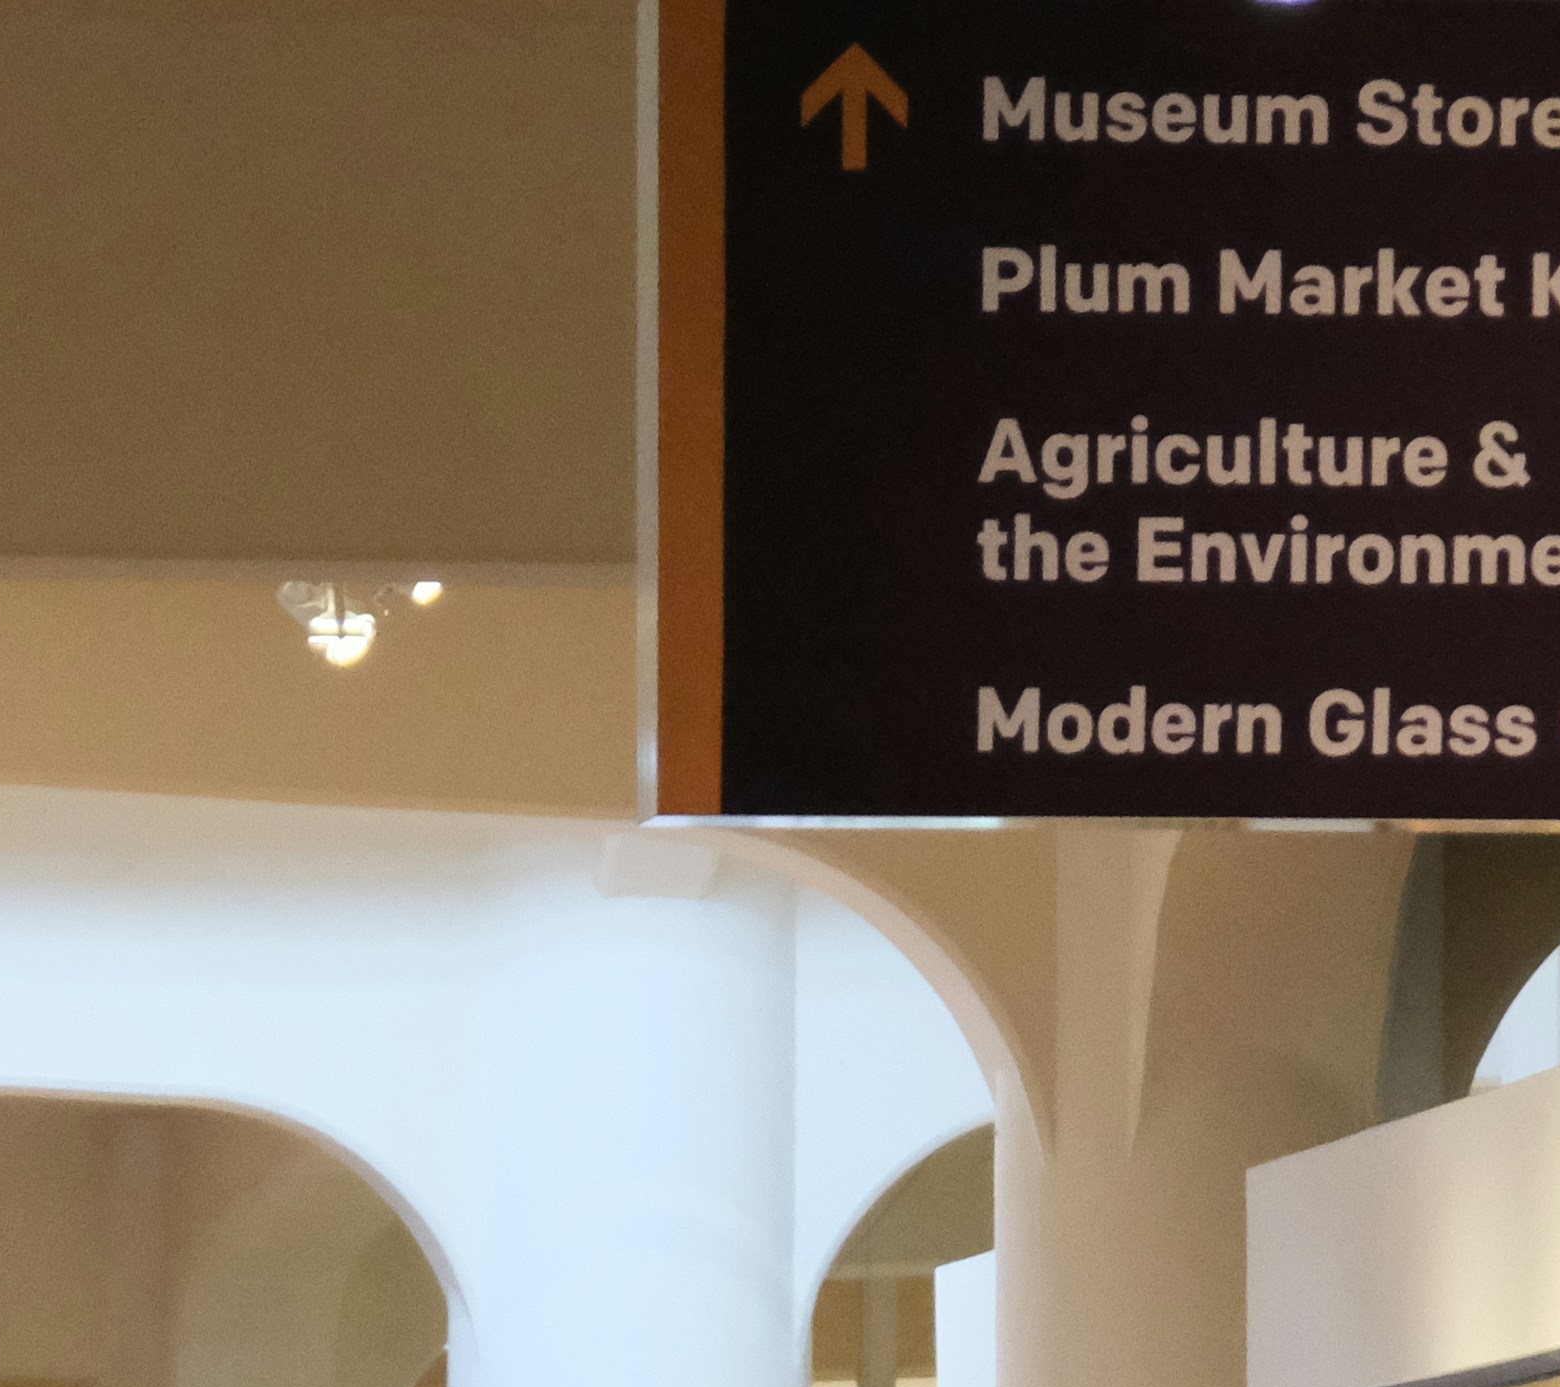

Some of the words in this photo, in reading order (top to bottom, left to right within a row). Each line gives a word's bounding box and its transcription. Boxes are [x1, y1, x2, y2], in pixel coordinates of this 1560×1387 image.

[982, 75, 1330, 146] Museum
[980, 243, 1191, 315] Plum
[1217, 246, 1507, 319] Market
[978, 414, 1450, 500] Agriculture
[1471, 419, 1532, 489] &
[976, 513, 1110, 584] the
[976, 684, 1284, 757] Modern
[1307, 686, 1539, 759] Glass
